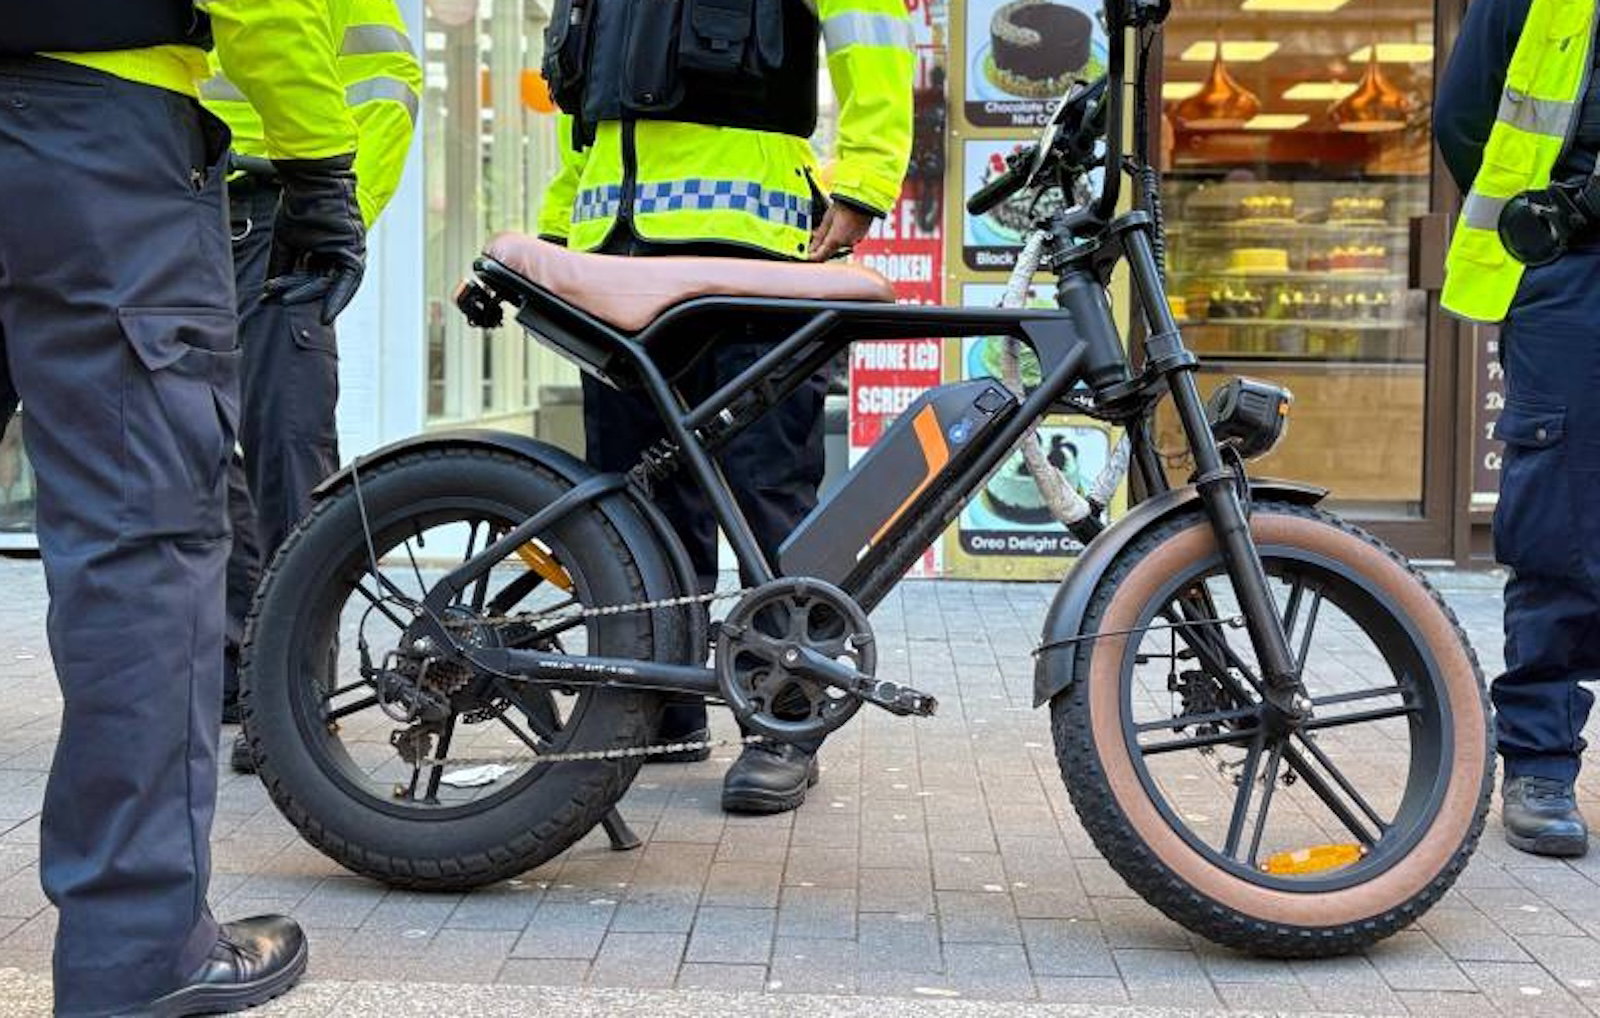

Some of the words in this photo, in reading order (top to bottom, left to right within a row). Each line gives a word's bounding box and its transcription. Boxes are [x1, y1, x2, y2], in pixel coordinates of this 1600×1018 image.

[1012, 114, 1034, 125] Nut
[976, 251, 1014, 265] Black
[855, 343, 907, 371] PHONE
[908, 342, 939, 371] LCD
[971, 536, 1005, 550] Oreo
[1008, 536, 1058, 553] Delight
